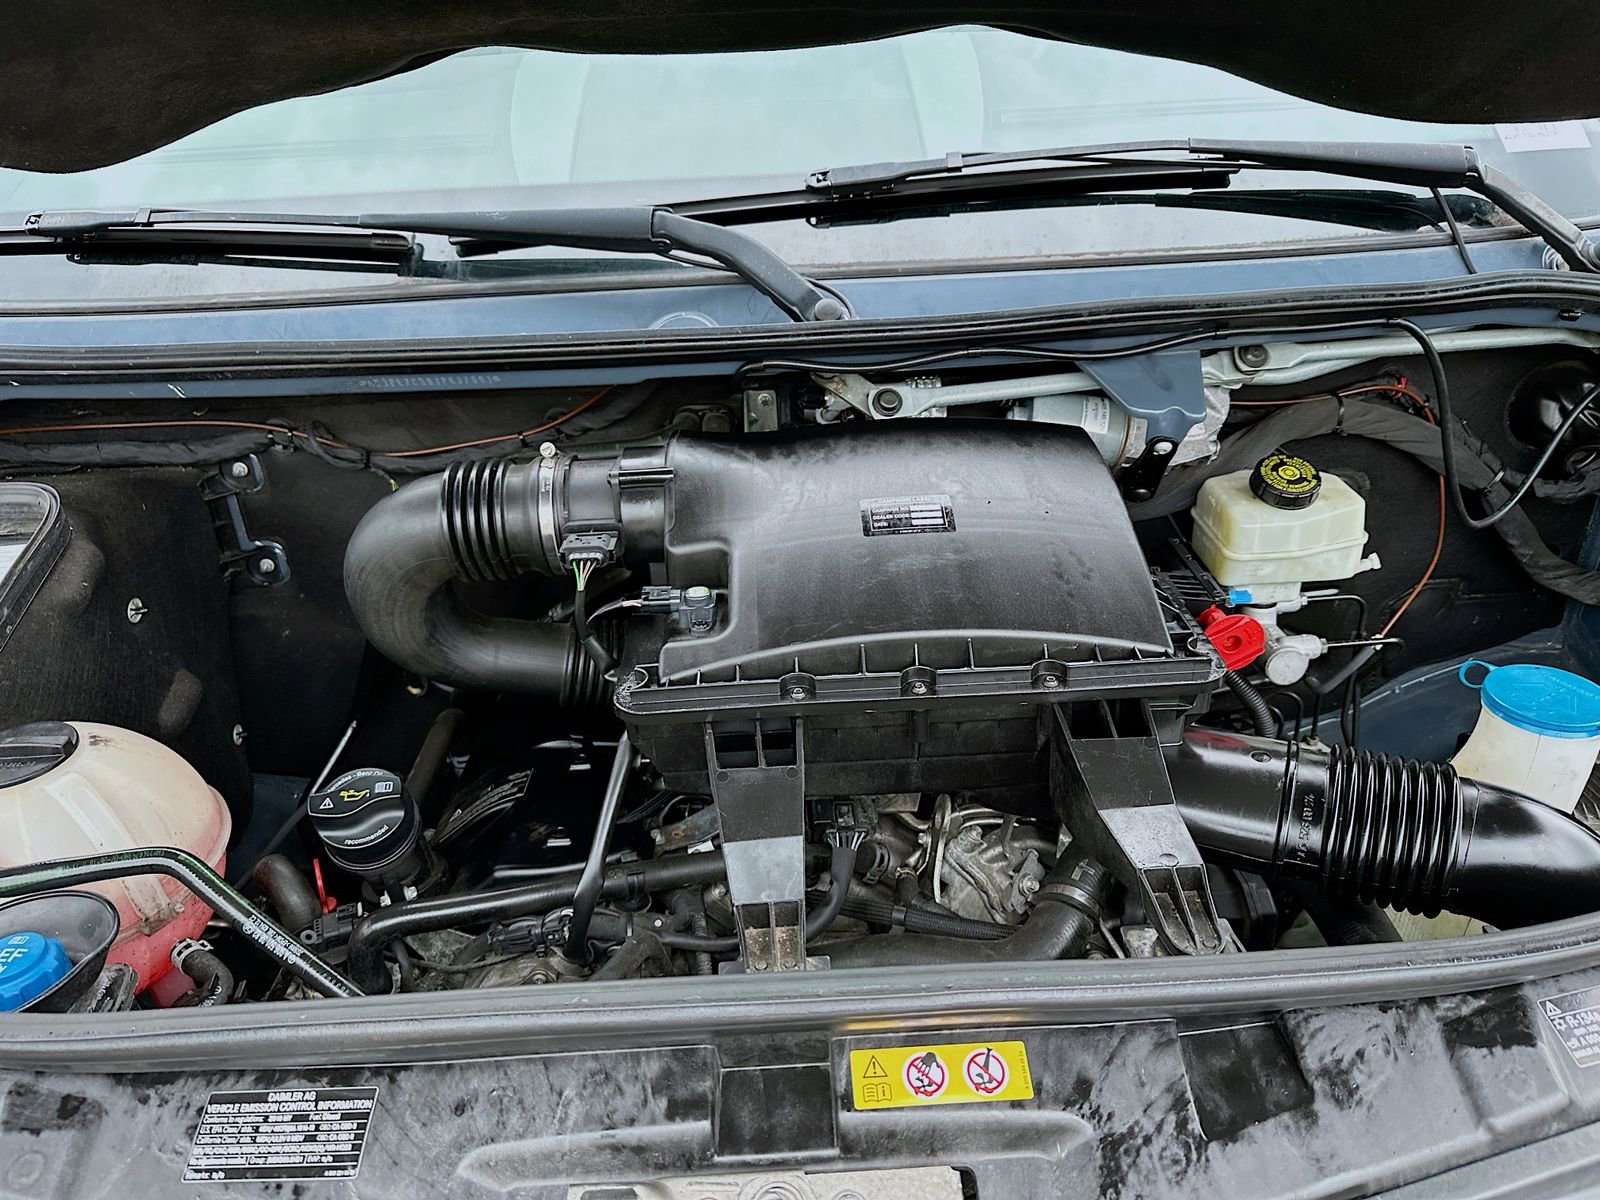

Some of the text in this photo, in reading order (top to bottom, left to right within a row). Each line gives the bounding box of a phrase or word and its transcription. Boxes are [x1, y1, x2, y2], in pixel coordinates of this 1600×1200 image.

[344, 824, 389, 845] recommended
[0, 948, 29, 963] EF
[303, 1091, 317, 1101] AG
[207, 1099, 373, 1114] VEHICLE EMISSION CONTROL INFORMATION
